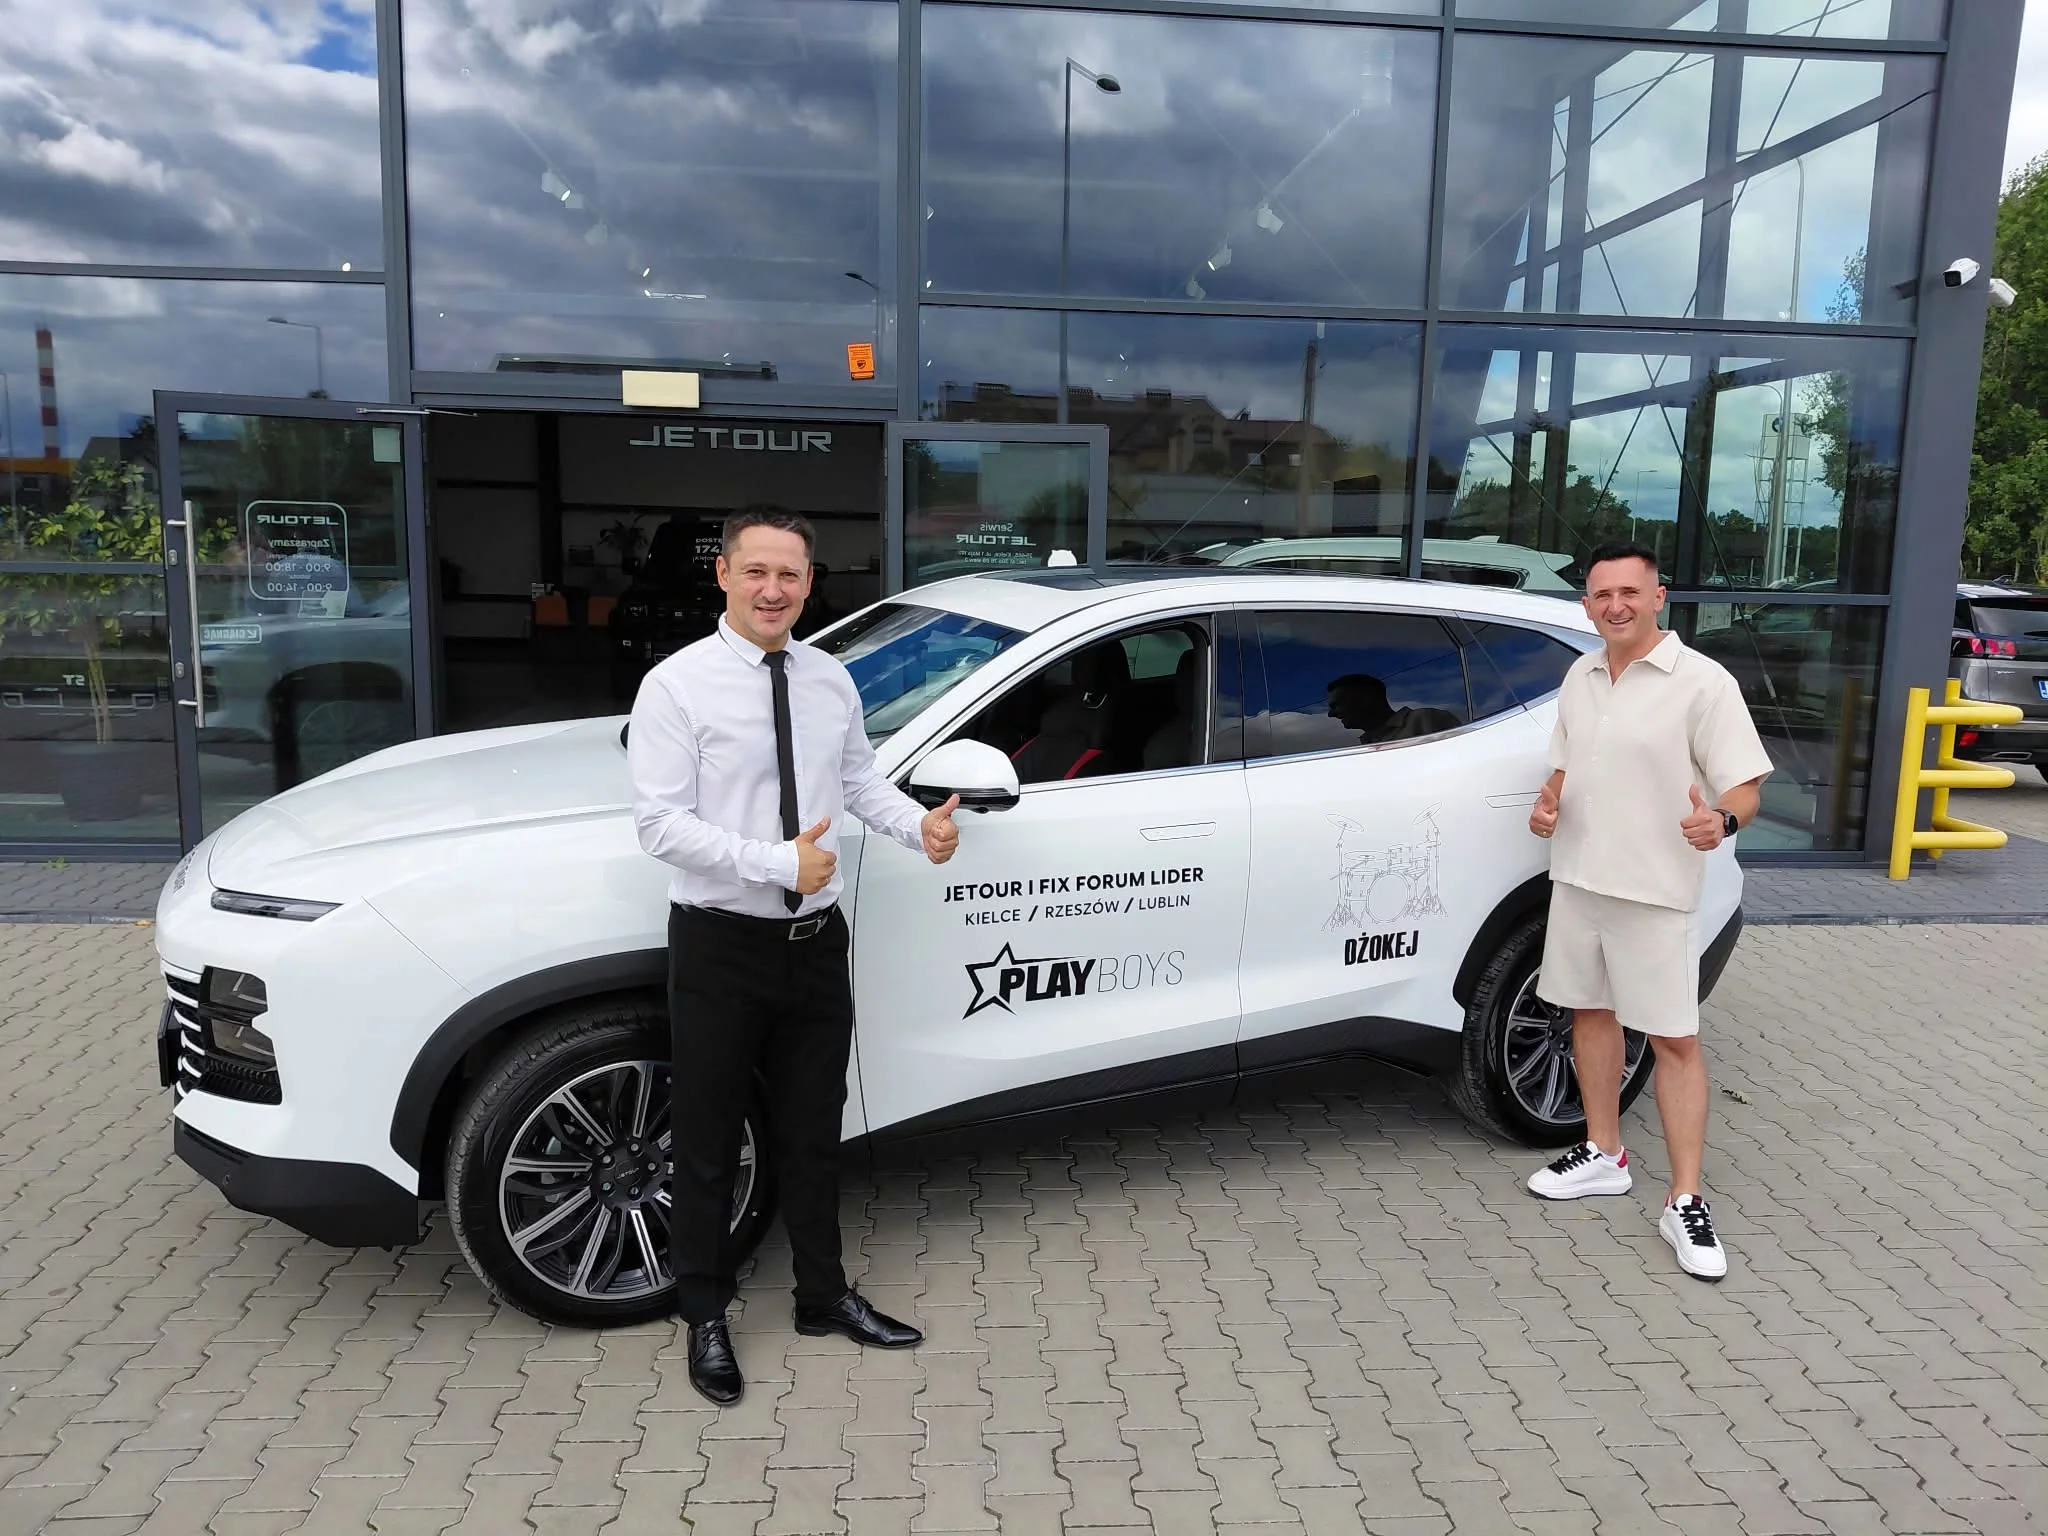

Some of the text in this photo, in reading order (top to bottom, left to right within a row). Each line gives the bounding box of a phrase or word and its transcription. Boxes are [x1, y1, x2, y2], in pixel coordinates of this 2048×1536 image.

[629, 425, 832, 453] JETOUR
[944, 881, 1023, 903] JETOUR
[1039, 877, 1070, 894] FIX
[1075, 871, 1145, 891] FORUM
[1150, 867, 1204, 885] LIDER
[965, 909, 1021, 926] KIELCE
[1045, 898, 1120, 919] RZESZÓW
[1138, 894, 1190, 911] LUBLIN
[1344, 930, 1419, 966] DŻOKEJ
